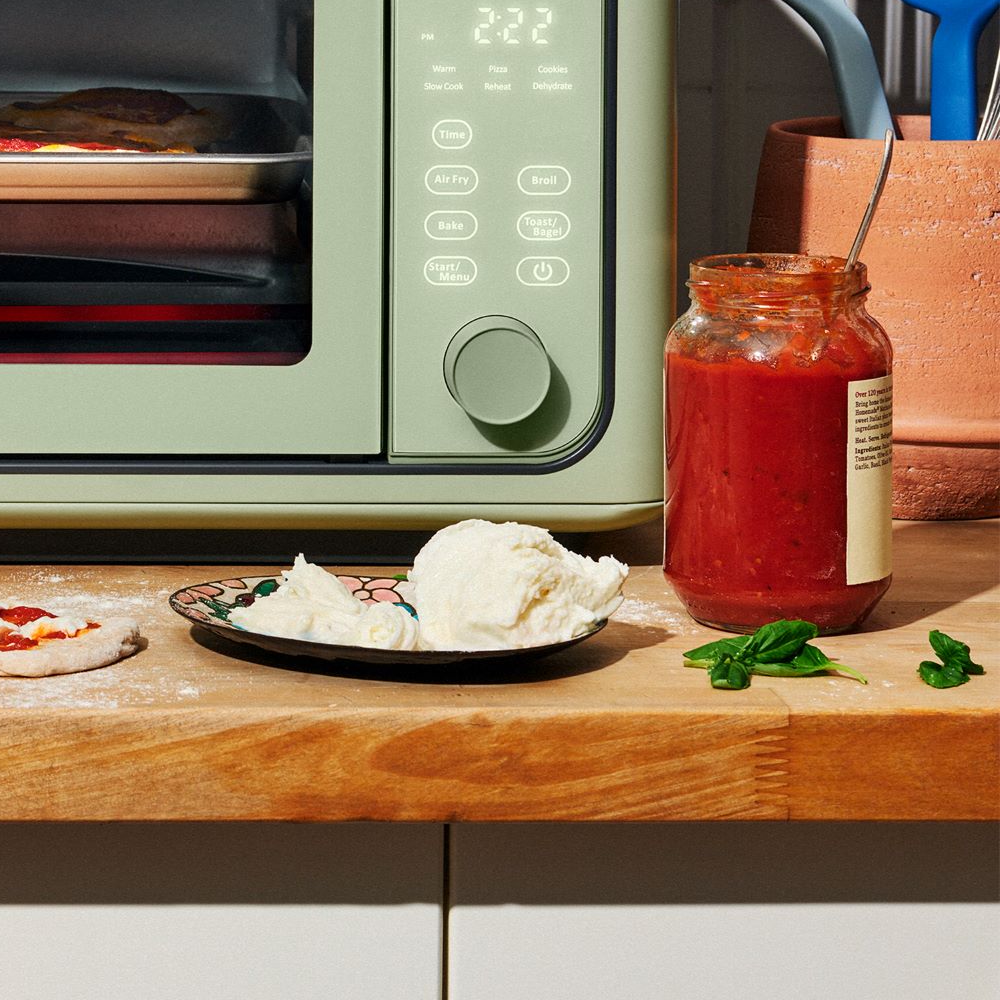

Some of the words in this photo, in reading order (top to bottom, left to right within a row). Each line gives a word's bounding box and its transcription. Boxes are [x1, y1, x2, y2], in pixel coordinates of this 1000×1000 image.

[474, 7, 552, 44] 2:22
[421, 33, 435, 41] PM
[432, 65, 456, 73] Warm
[488, 65, 508, 73] Pizza
[537, 65, 568, 73] Cookies
[424, 82, 443, 91] Slow
[444, 82, 464, 91] Cook
[484, 82, 512, 91] Reheat
[533, 82, 573, 92] Dehydrate
[439, 130, 466, 139] Time
[434, 175, 450, 184] Air
[452, 175, 469, 186] Fry
[532, 176, 557, 185] Broil
[438, 221, 464, 231] Bake
[524, 217, 558, 228] Toast/
[533, 227, 562, 238] Bagel
[428, 262, 461, 272] Start/
[440, 272, 470, 281] Menu
[855, 391, 867, 399] Over
[868, 389, 876, 397] 120
